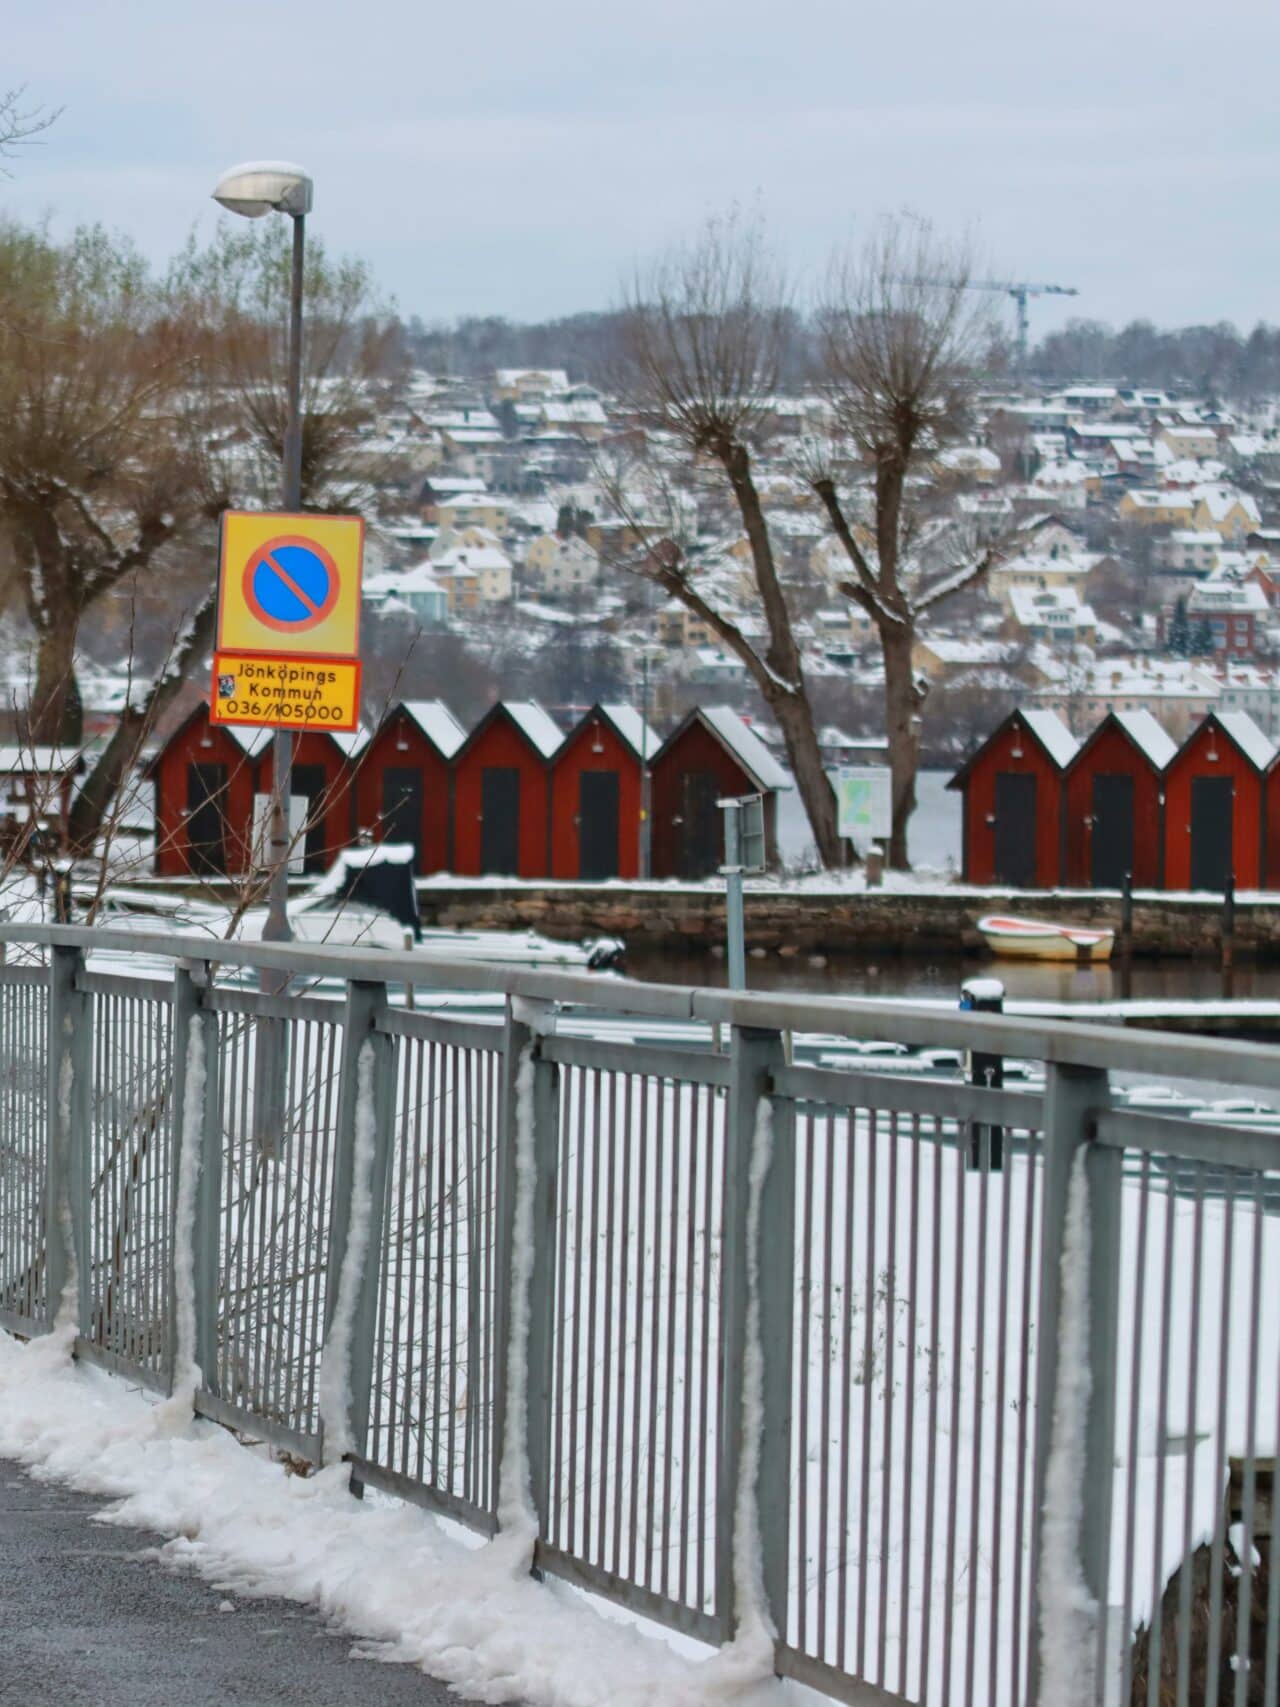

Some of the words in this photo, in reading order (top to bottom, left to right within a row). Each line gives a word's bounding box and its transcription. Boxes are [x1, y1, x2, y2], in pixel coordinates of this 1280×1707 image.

[237, 664, 336, 685] Jönköpings
[249, 683, 322, 700] Kommun
[226, 700, 343, 721] 036/105000
